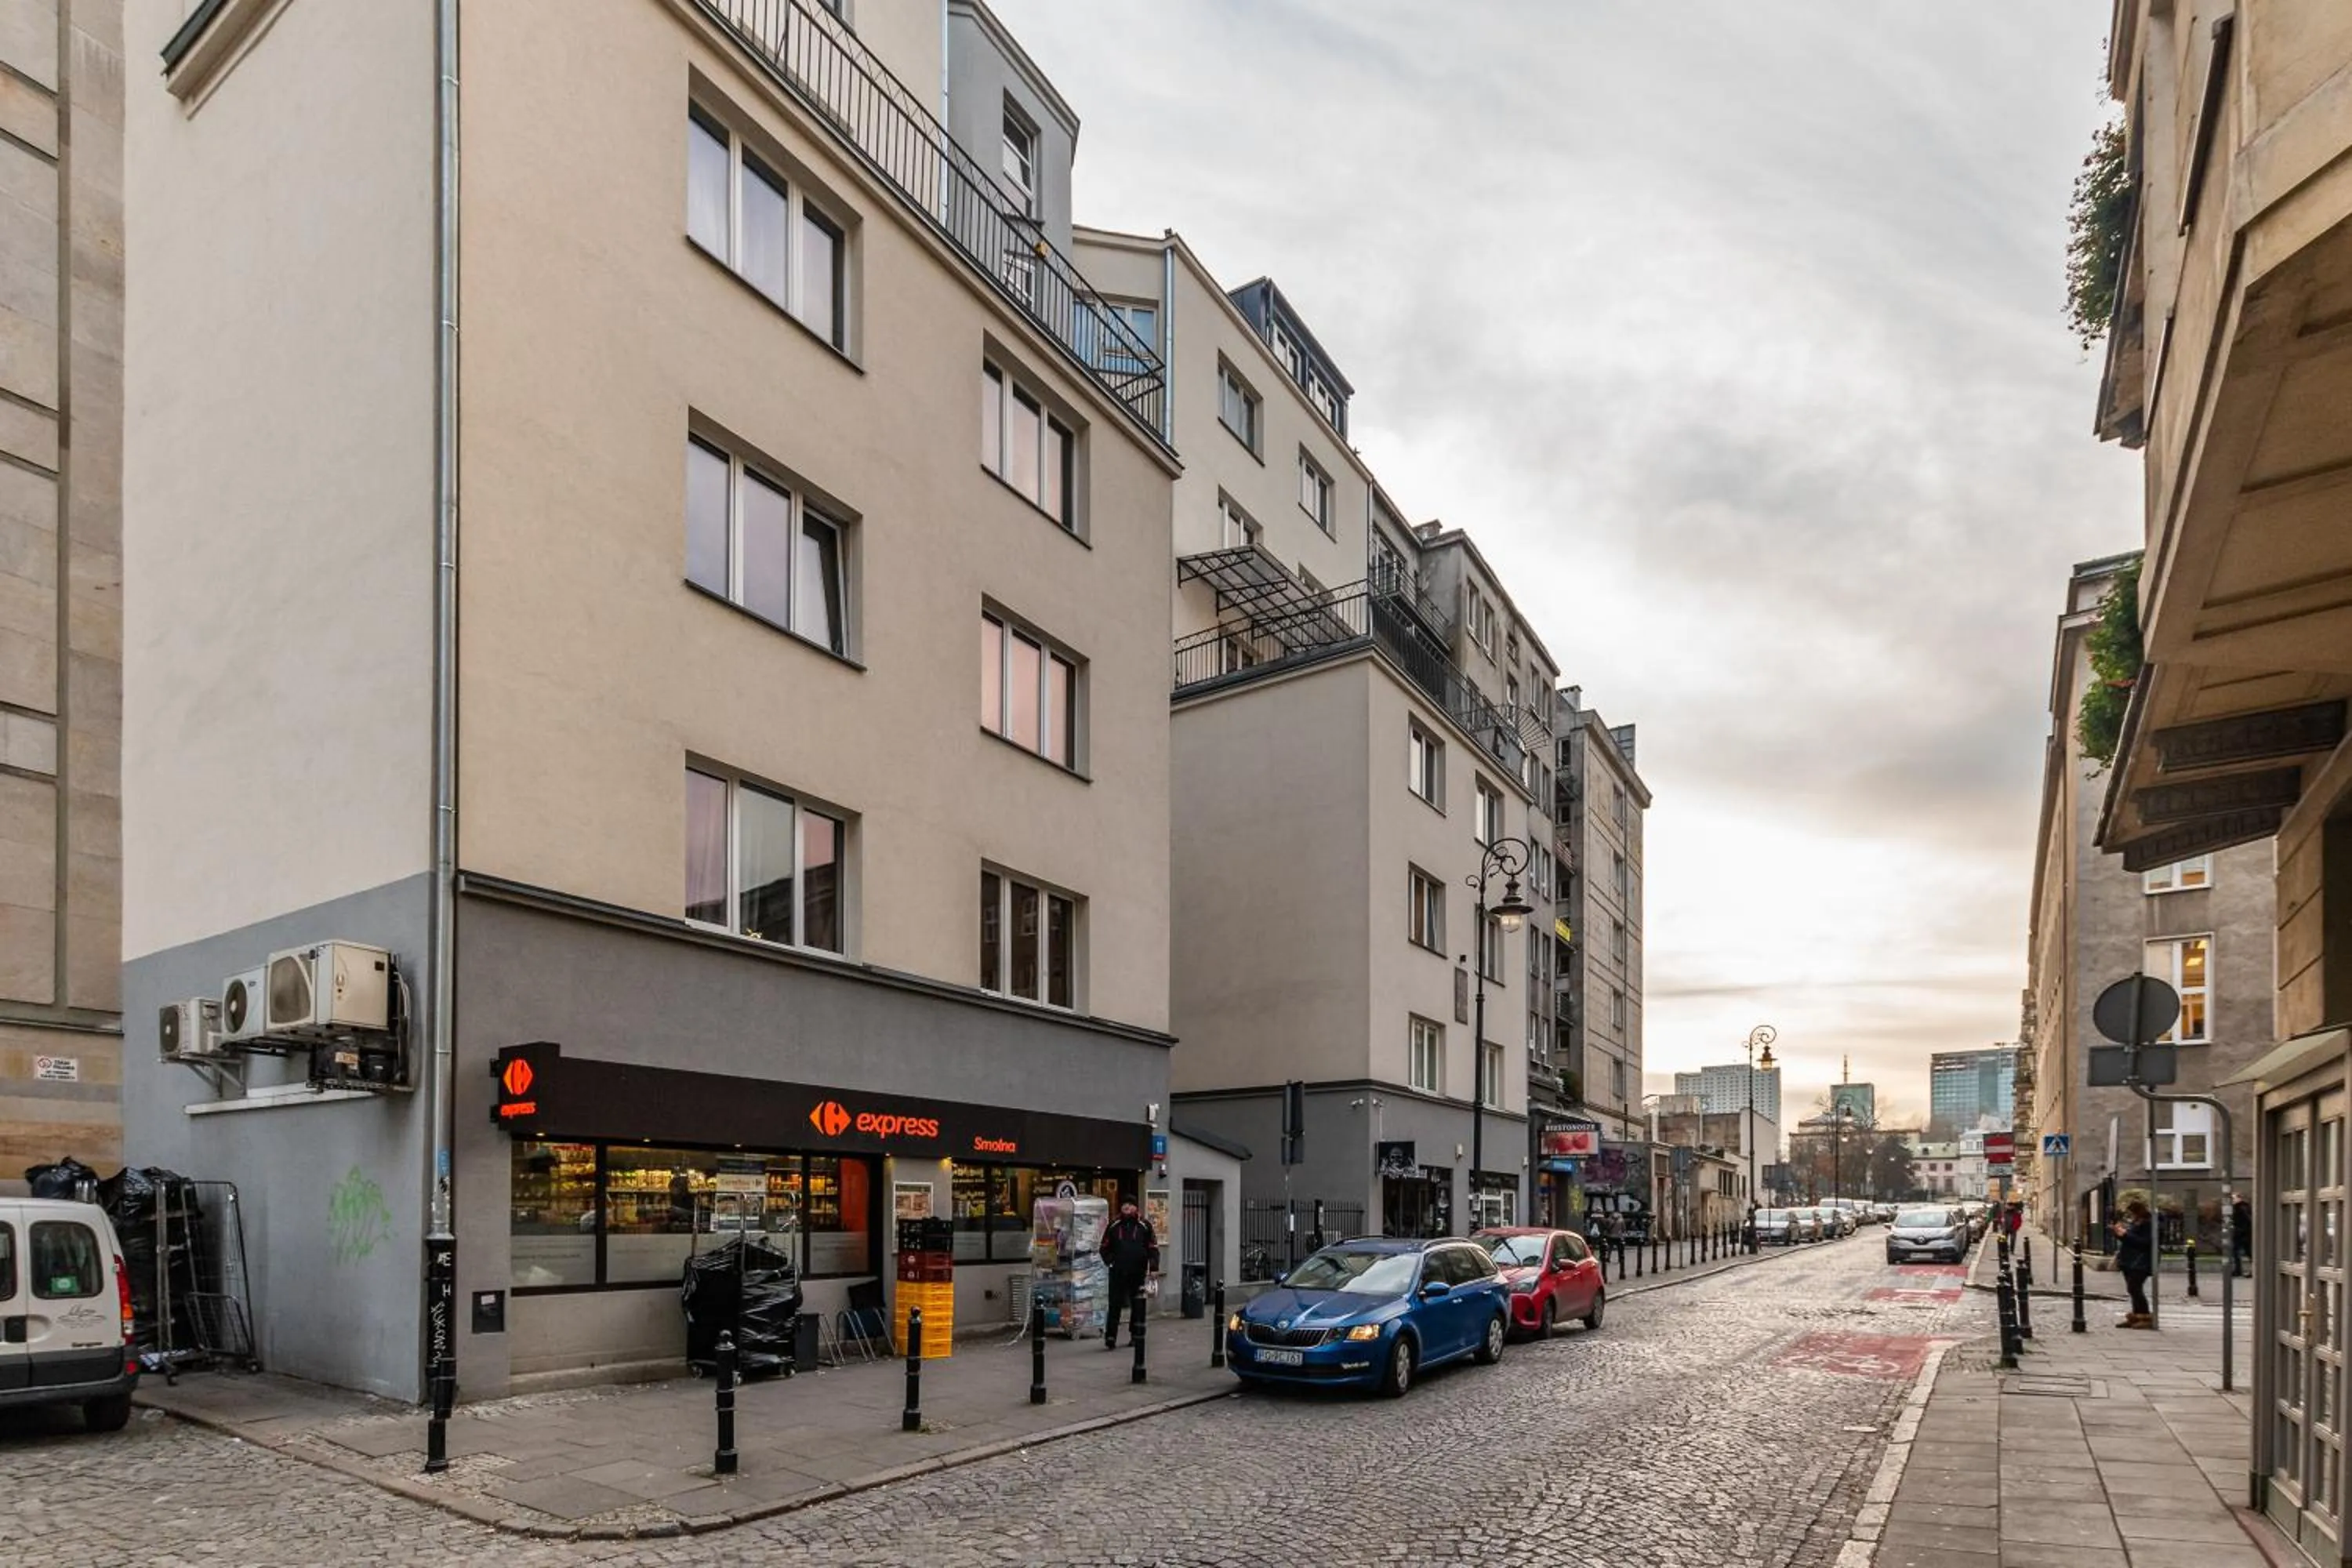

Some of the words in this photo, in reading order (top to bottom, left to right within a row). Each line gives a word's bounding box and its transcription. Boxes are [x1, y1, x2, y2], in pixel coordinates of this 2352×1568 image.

[500, 1102, 536, 1119] express
[856, 1112, 940, 1138] express
[973, 1136, 1016, 1153] Smolna
